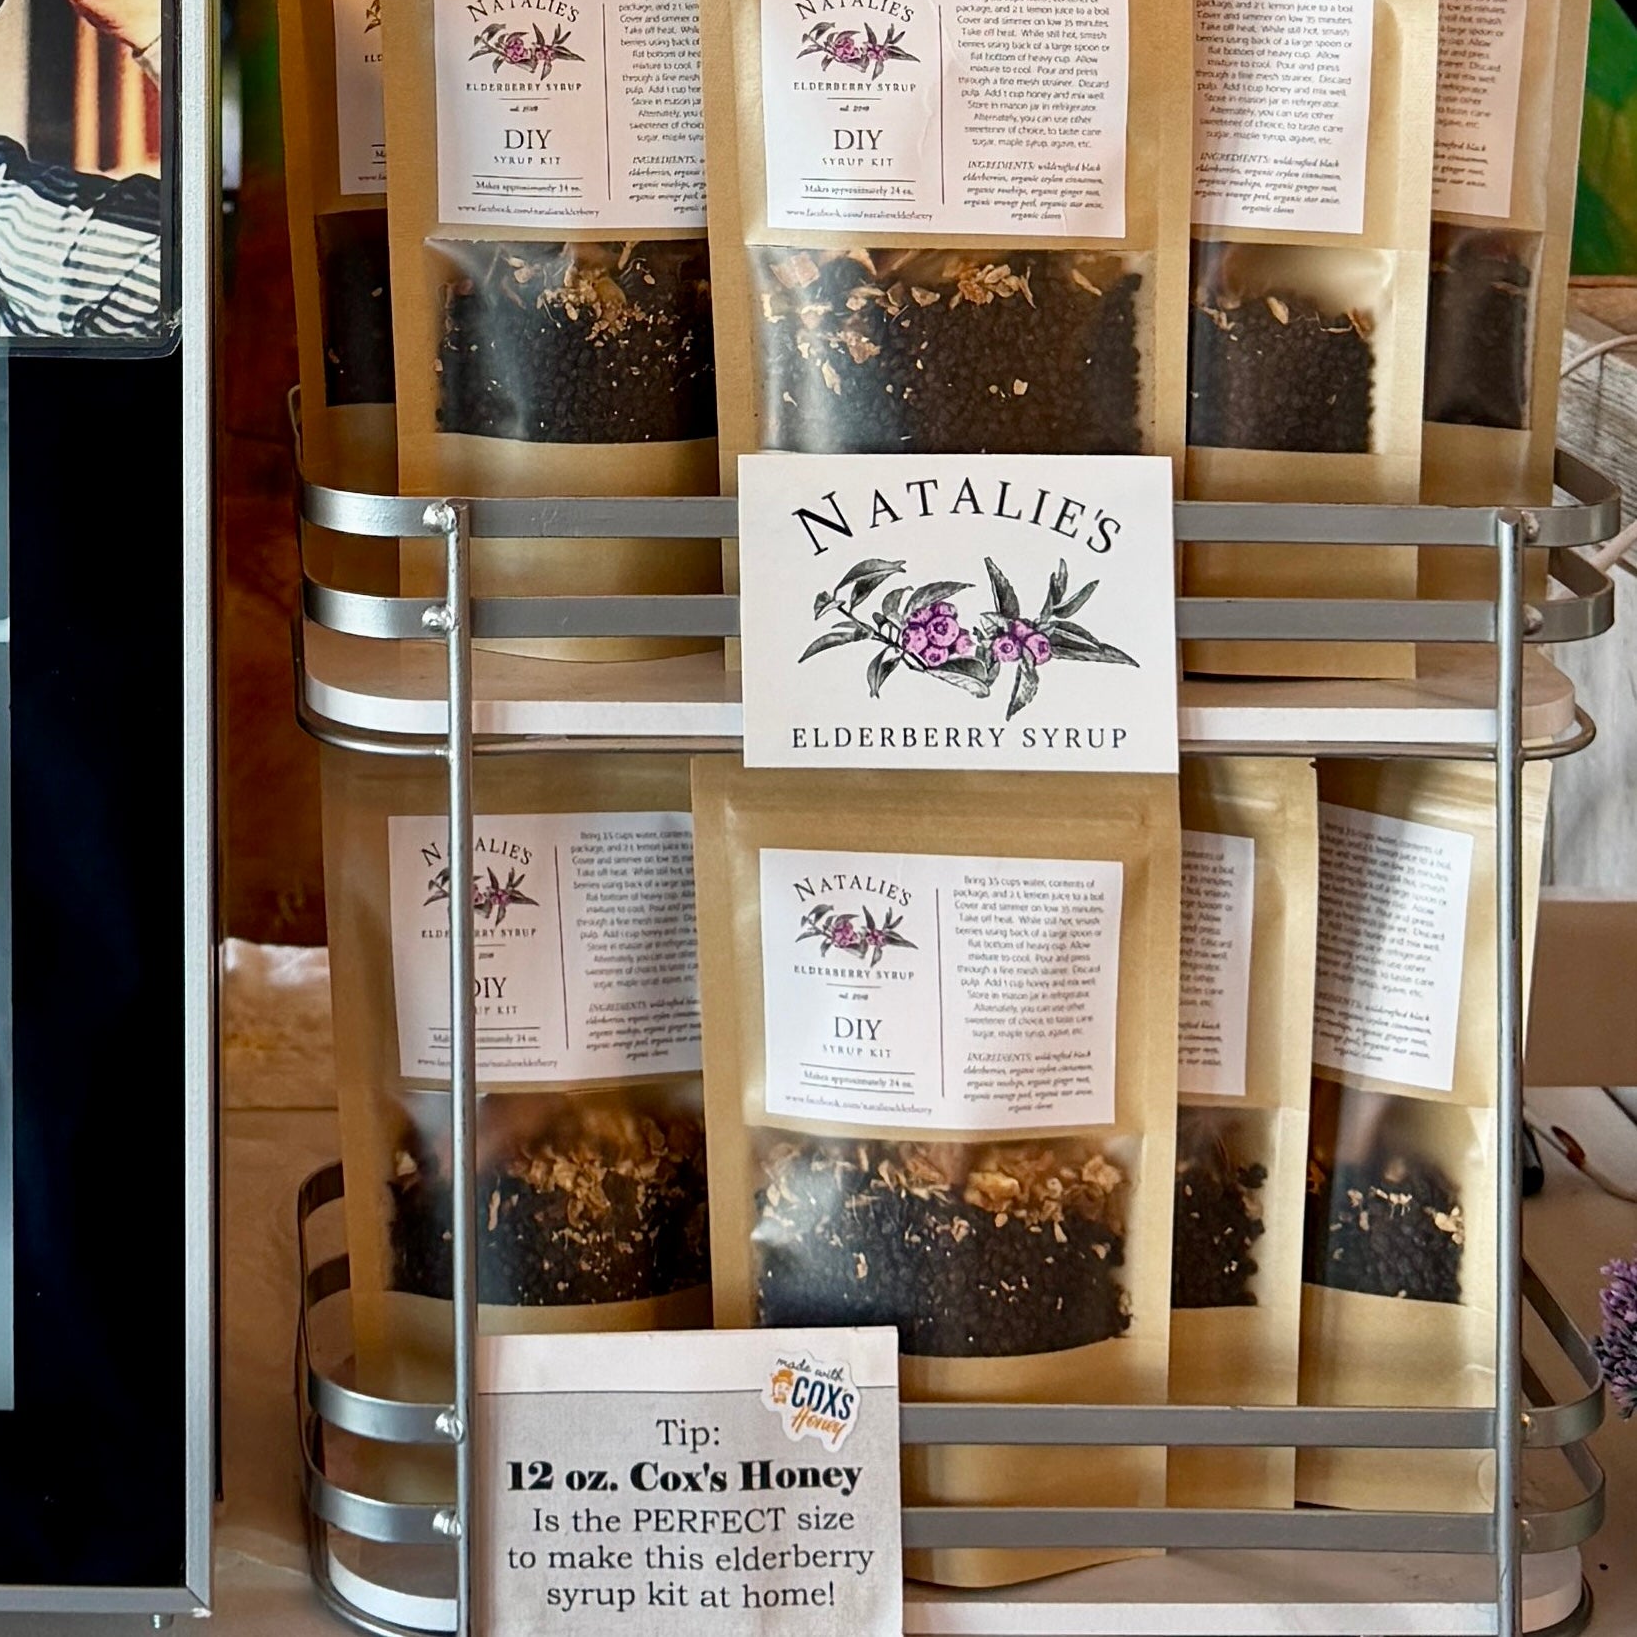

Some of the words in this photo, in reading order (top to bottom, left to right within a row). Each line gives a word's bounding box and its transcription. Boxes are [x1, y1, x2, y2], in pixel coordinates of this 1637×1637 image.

[504, 129, 552, 150] DIY
[834, 129, 883, 151] DIY
[822, 157, 864, 167] SYRUP
[872, 158, 894, 167] KIT
[792, 477, 1121, 555] NATALIE'S
[792, 727, 1005, 749] ELDERBERRY
[1022, 728, 1128, 749] SYRUP
[793, 874, 912, 907] NATALIE'S
[834, 1016, 882, 1041] DIY
[656, 1419, 720, 1452] Tip:
[506, 1461, 553, 1492] 12
[566, 1468, 618, 1492] oz.
[630, 1461, 727, 1493] Cox's
[738, 1460, 863, 1496] Honey
[533, 1509, 559, 1532] Is
[573, 1508, 620, 1533] the
[633, 1508, 786, 1534] PERFECT
[797, 1507, 854, 1531] size
[509, 1547, 536, 1570] to
[549, 1546, 632, 1570] make
[646, 1546, 703, 1570] this
[716, 1545, 874, 1574] elderberry
[547, 1587, 635, 1612] syrup
[648, 1582, 689, 1607] kit
[700, 1585, 730, 1608] at
[742, 1582, 835, 1608] home!
